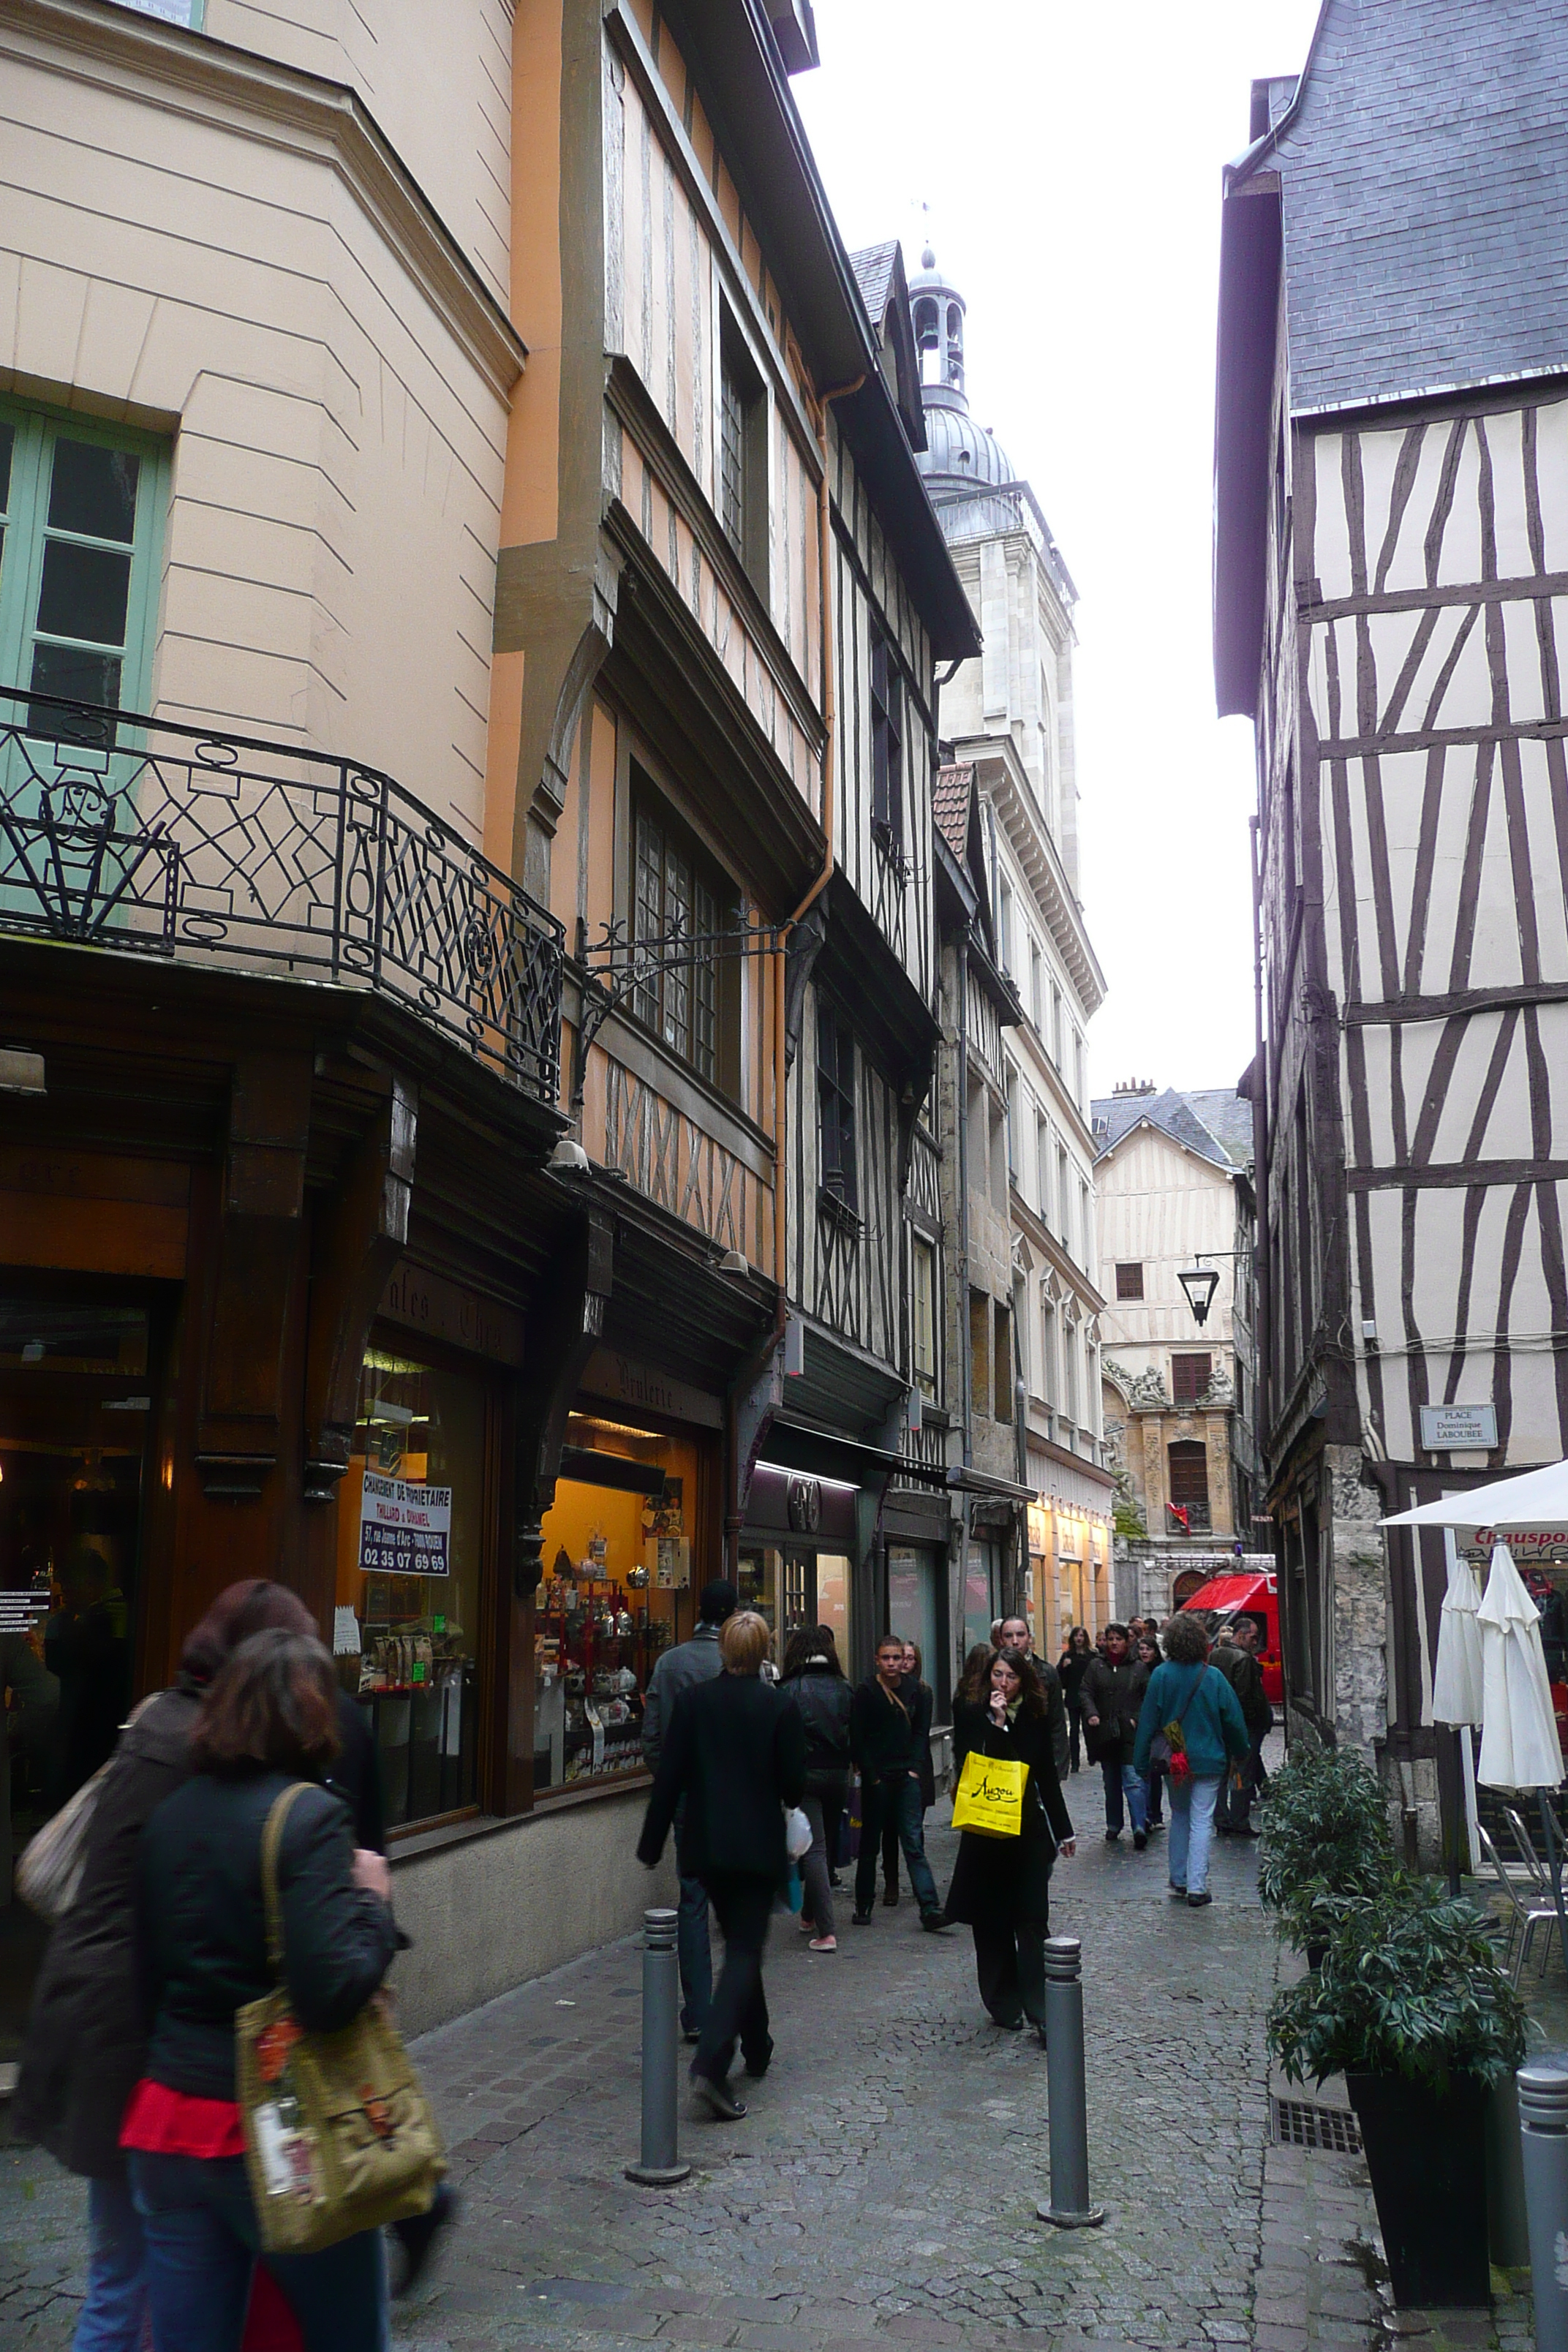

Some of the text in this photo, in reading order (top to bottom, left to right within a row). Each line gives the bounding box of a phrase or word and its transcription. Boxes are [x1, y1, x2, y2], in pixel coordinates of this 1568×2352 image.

[1444, 1411, 1472, 1420] PLACE
[1437, 1421, 1481, 1429] Dominique
[363, 1474, 394, 1499] CHANGEMENT
[396, 1484, 405, 1501] DE
[396, 1531, 410, 1547] d'Arc
[1474, 1530, 1568, 1547] Chauspo
[363, 1548, 444, 1570] 02 35 07 69 69
